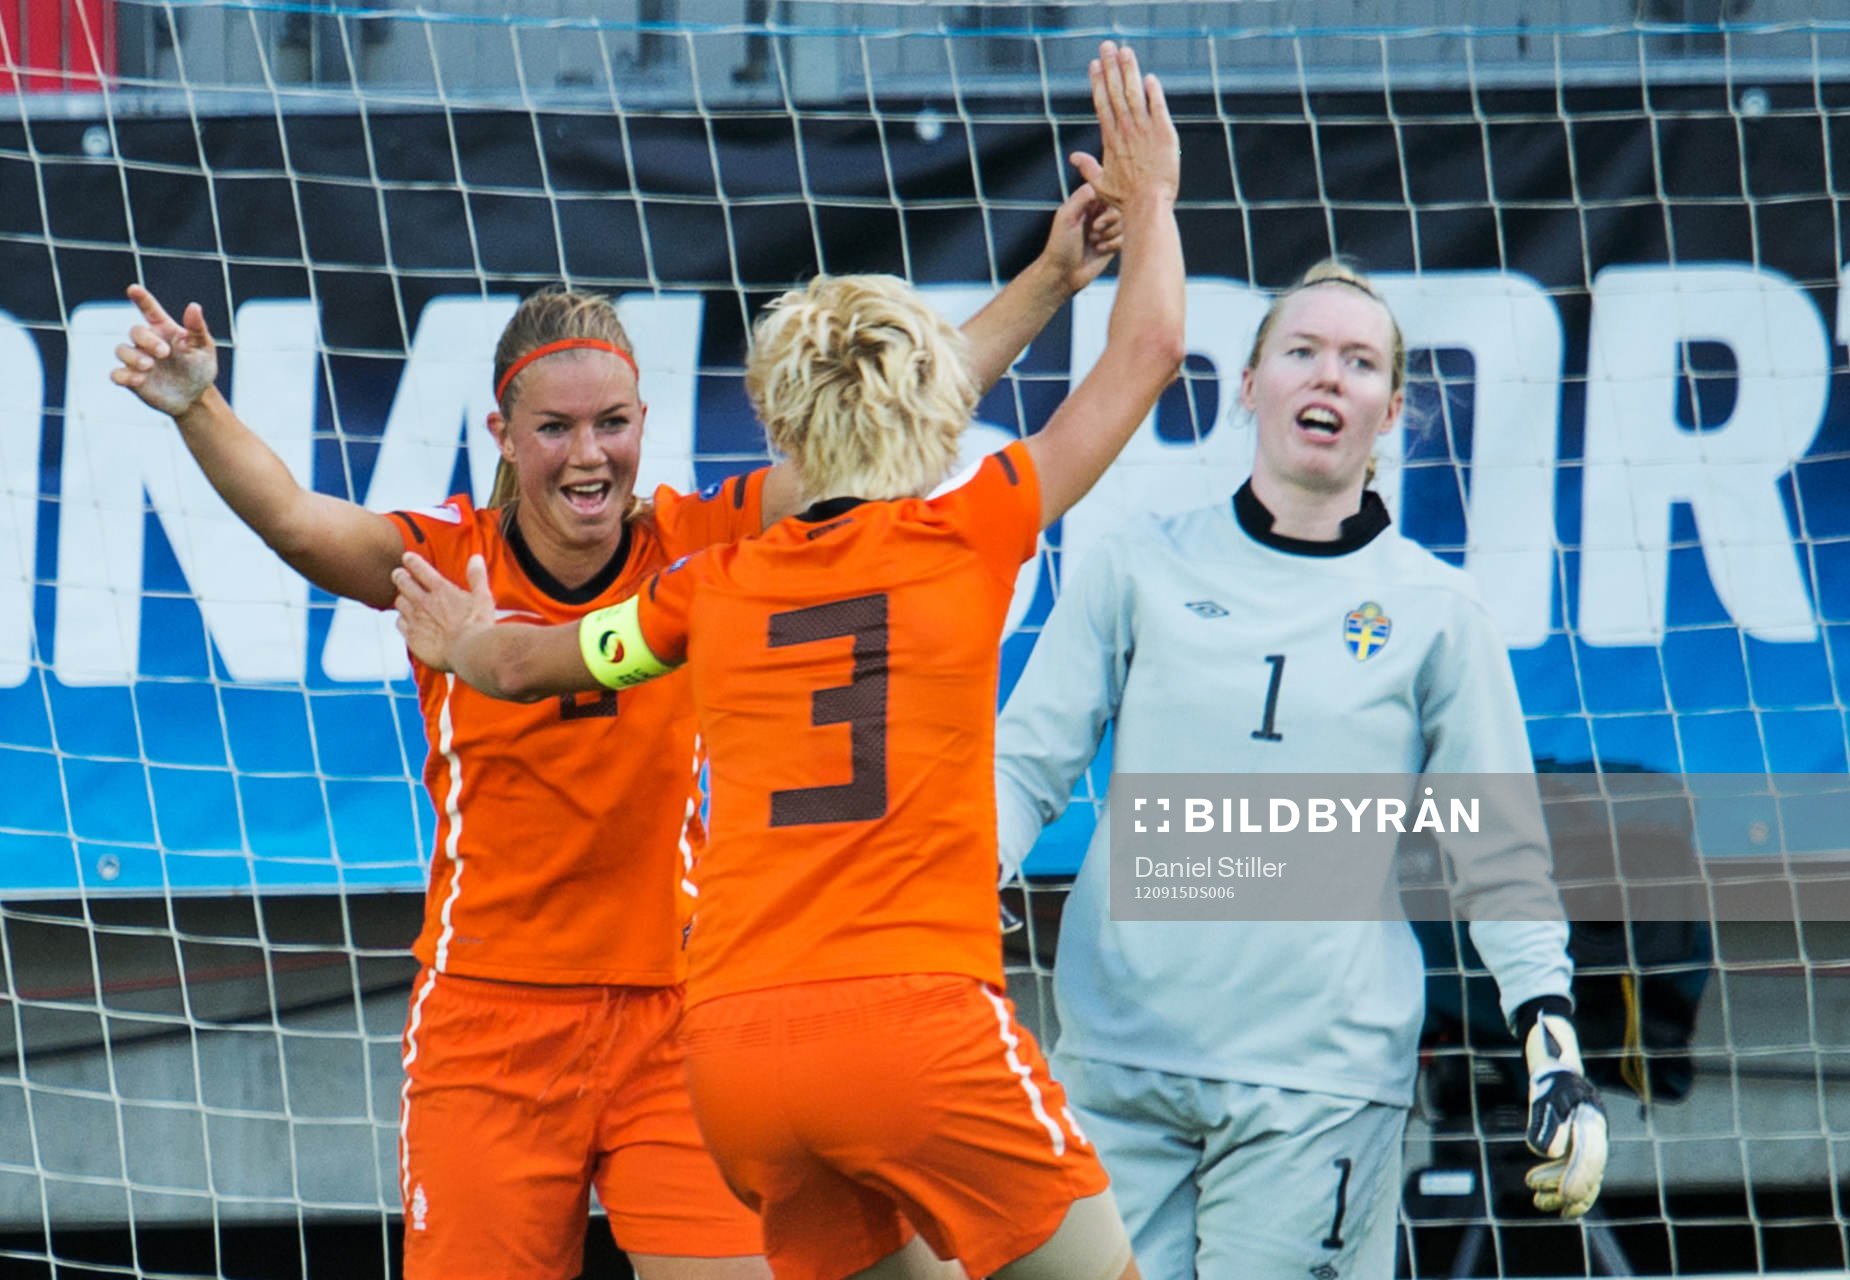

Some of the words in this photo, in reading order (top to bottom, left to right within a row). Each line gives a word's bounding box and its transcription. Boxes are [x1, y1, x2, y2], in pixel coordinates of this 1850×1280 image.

[768, 593, 888, 828] 3
[1251, 654, 1286, 742] 1
[1321, 1157, 1352, 1250] 1
